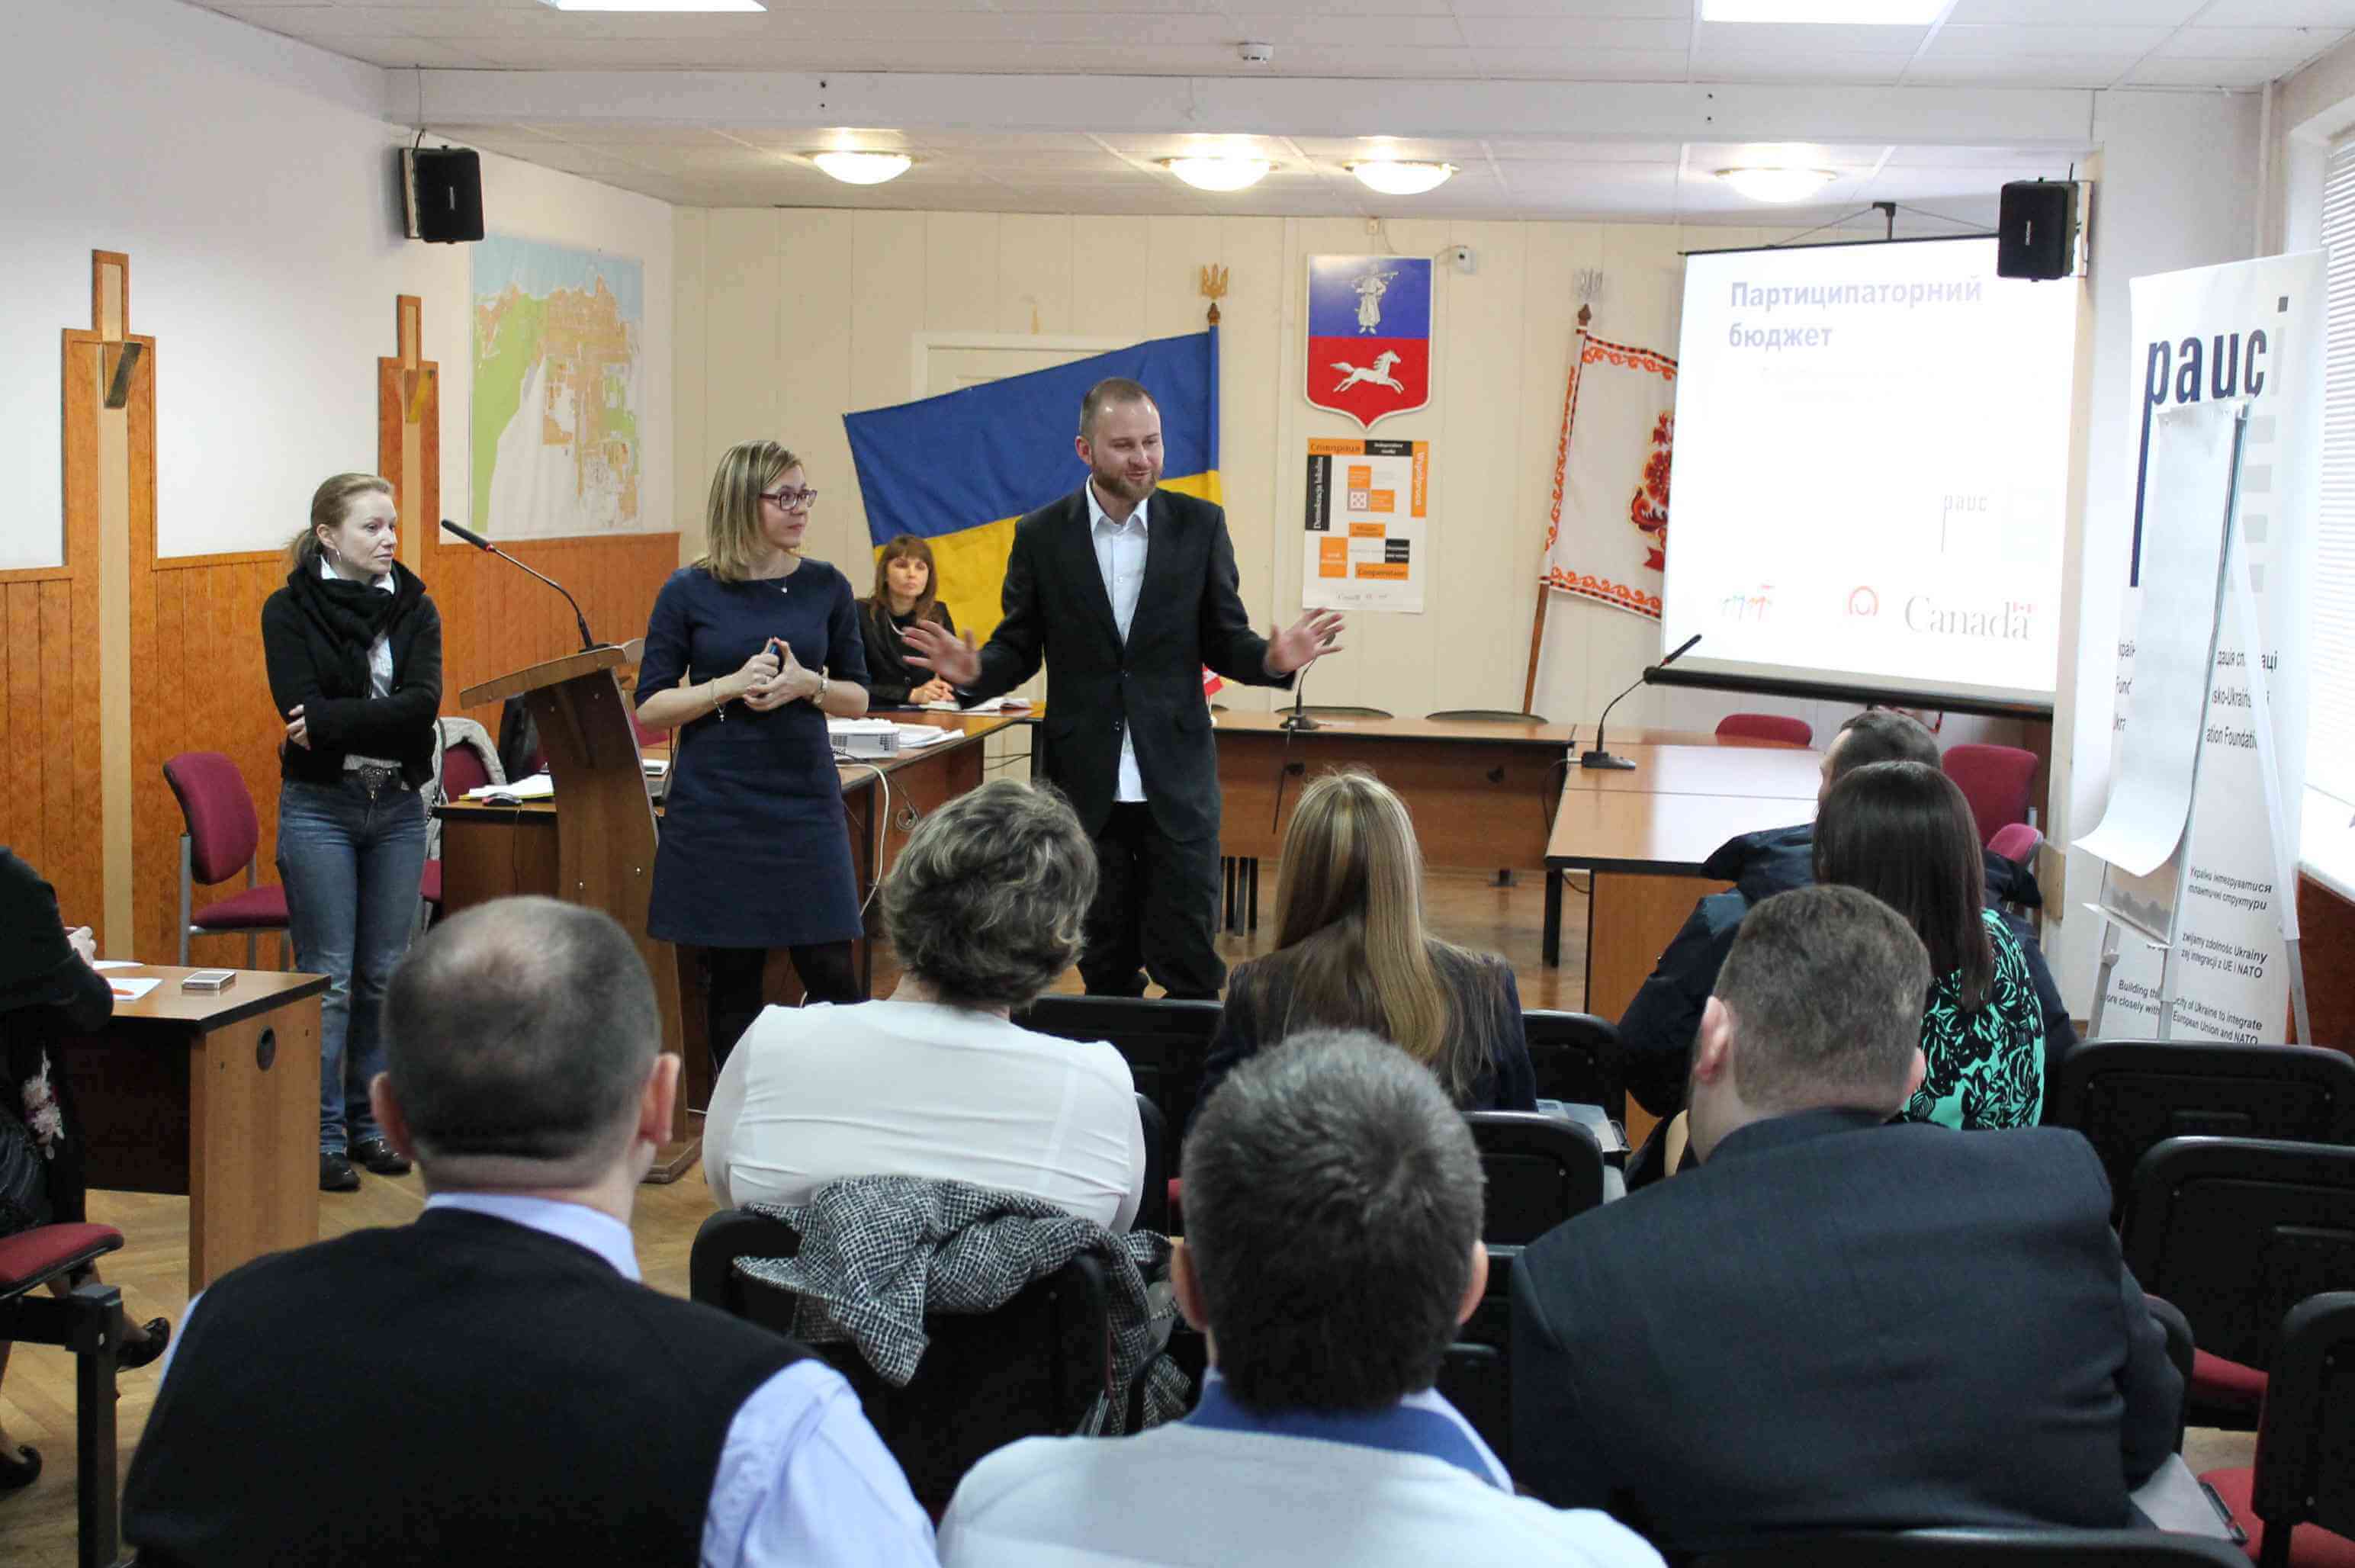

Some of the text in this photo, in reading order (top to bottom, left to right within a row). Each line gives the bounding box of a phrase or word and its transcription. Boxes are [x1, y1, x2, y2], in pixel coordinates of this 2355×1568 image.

[1730, 275, 1983, 312] Партиципаторний
[1728, 322, 1833, 352] бюджет
[1904, 594, 2032, 641] Canada
[2237, 962, 2263, 978] NATO
[2118, 979, 2149, 998] Building
[2194, 1001, 2218, 1020] Ukraine
[2218, 1010, 2226, 1021] to
[2226, 1013, 2263, 1031] integrate
[2118, 998, 2145, 1016] closely
[2145, 1004, 2161, 1015] with
[2172, 1011, 2199, 1030] European
[2199, 1018, 2220, 1036] Union
[2219, 1029, 2233, 1042] and
[2233, 1031, 2259, 1045] NATO
